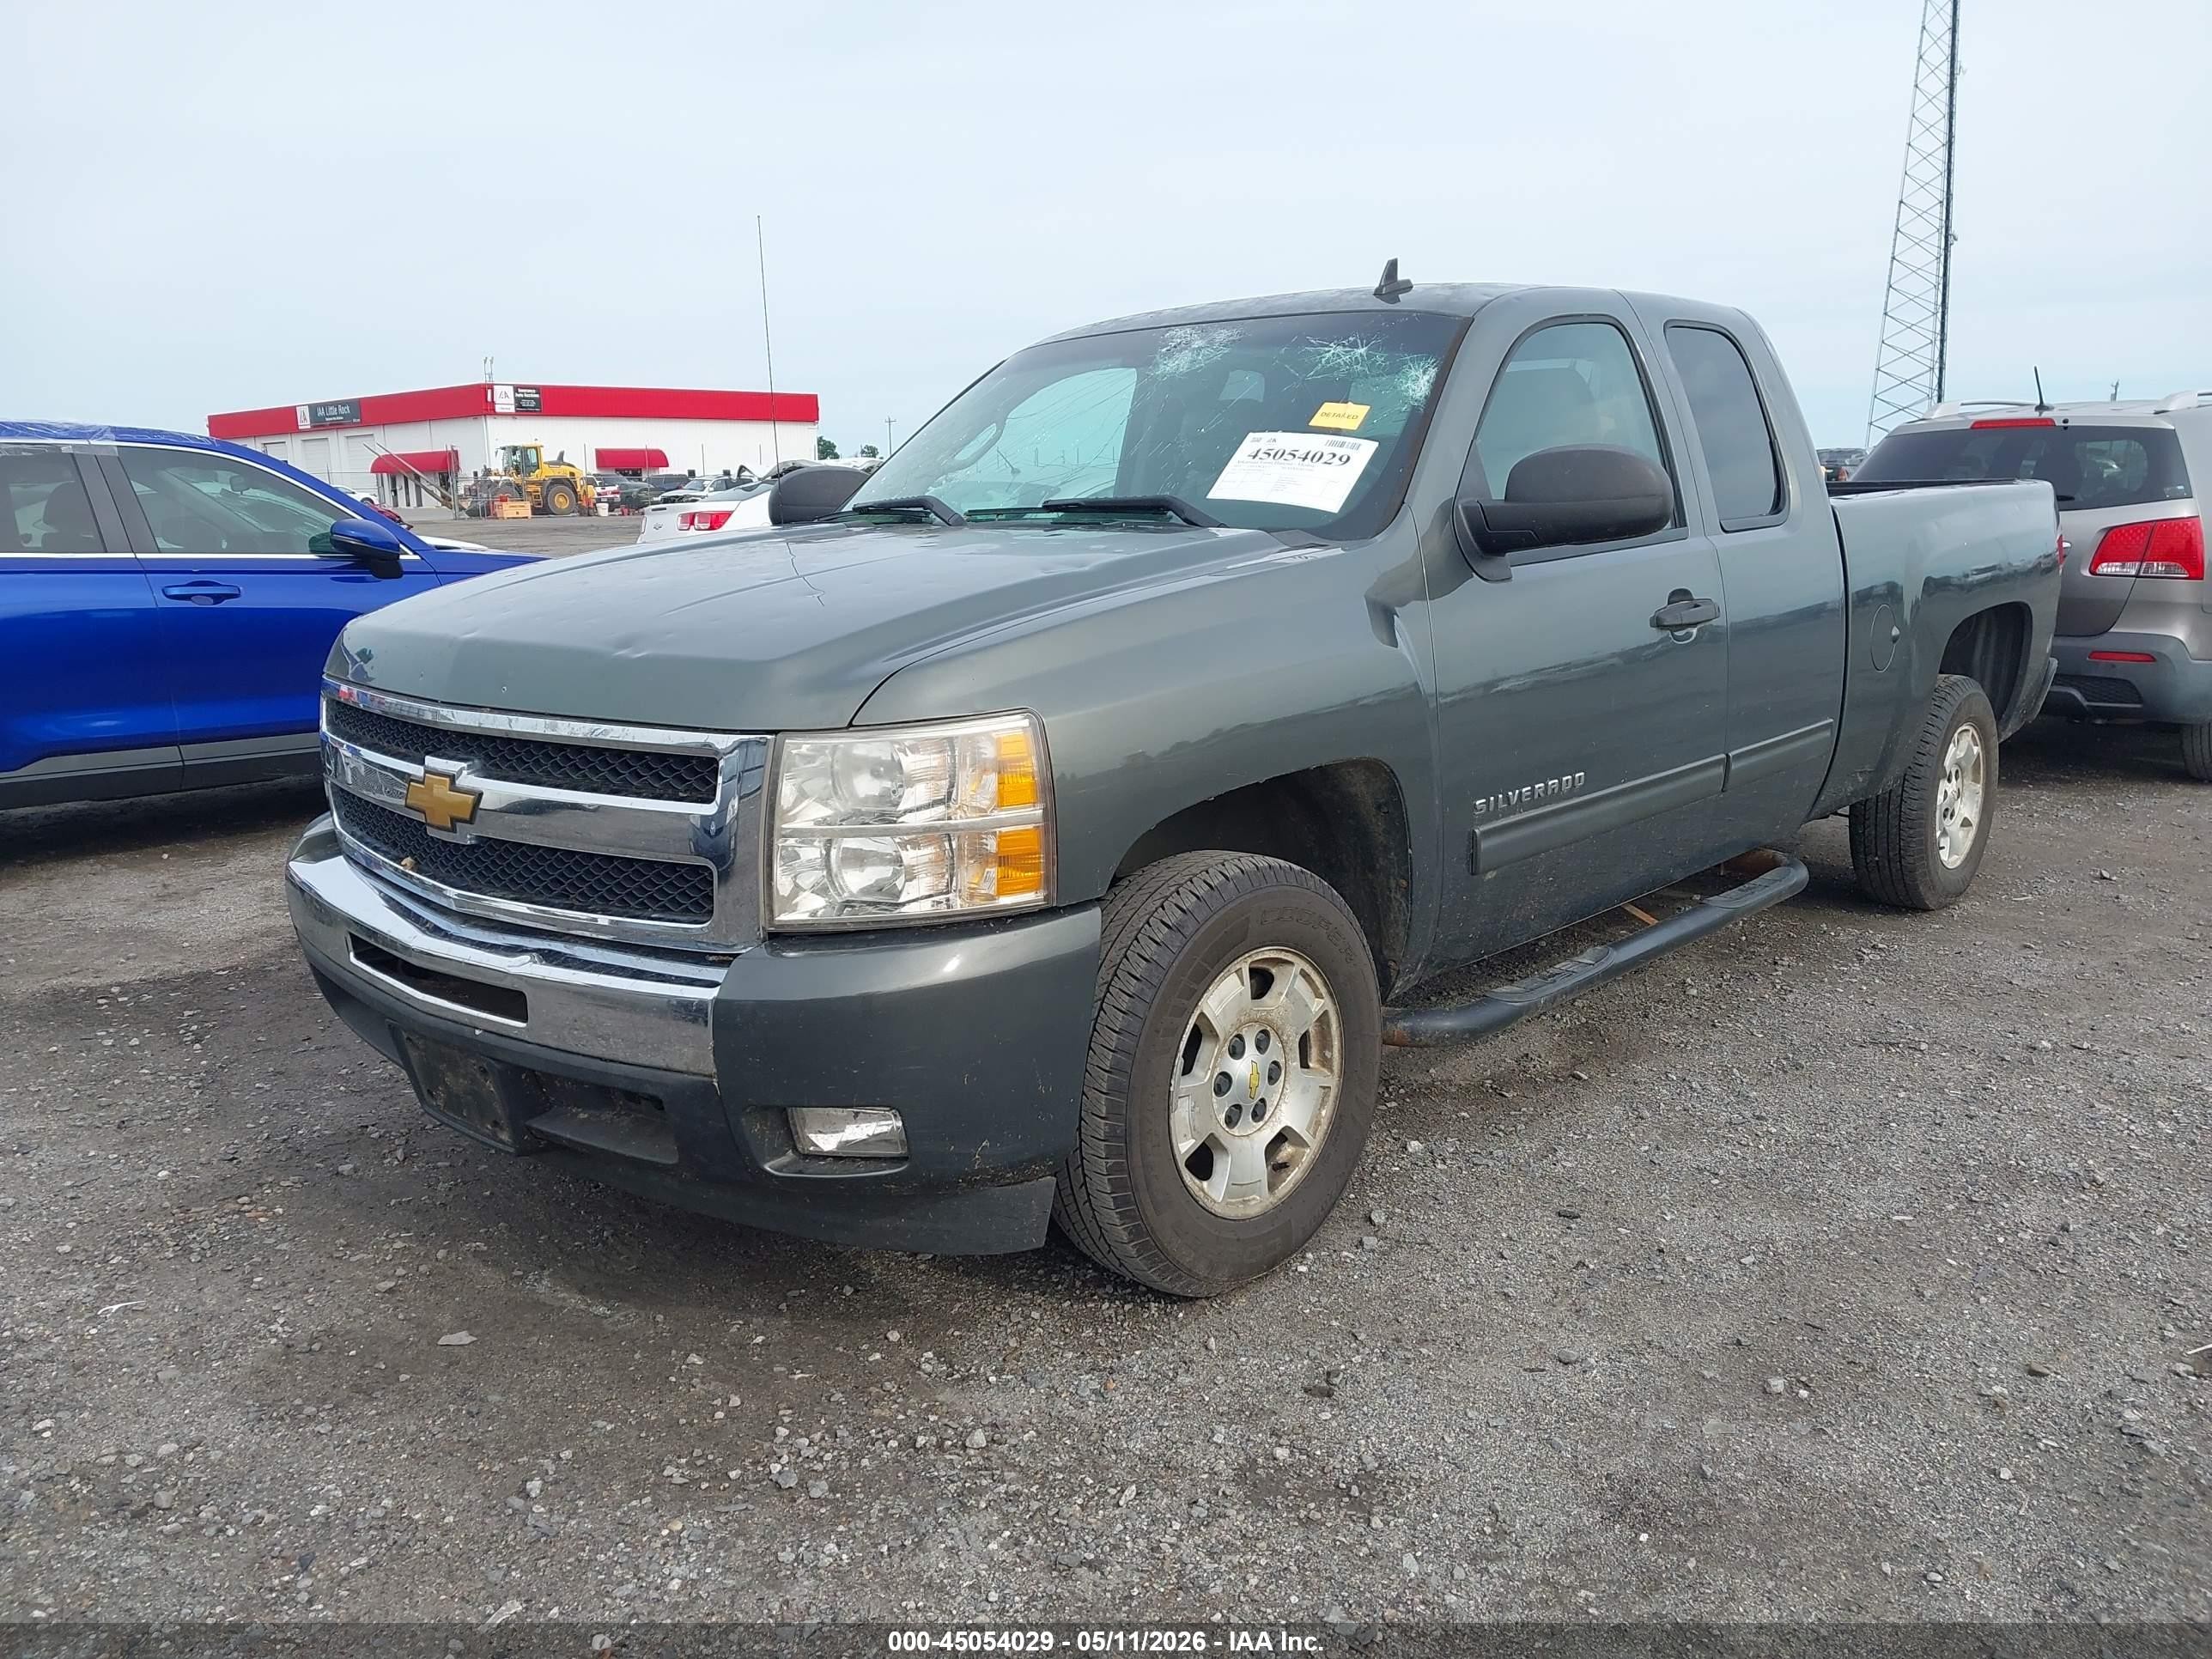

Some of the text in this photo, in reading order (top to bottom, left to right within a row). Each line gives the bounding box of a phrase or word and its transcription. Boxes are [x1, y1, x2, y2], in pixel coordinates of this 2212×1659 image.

[325, 405, 337, 416] Little
[338, 404, 350, 415] Rock
[1247, 447, 1352, 467] 45054029
[1474, 771, 1586, 815] SILVERADO
